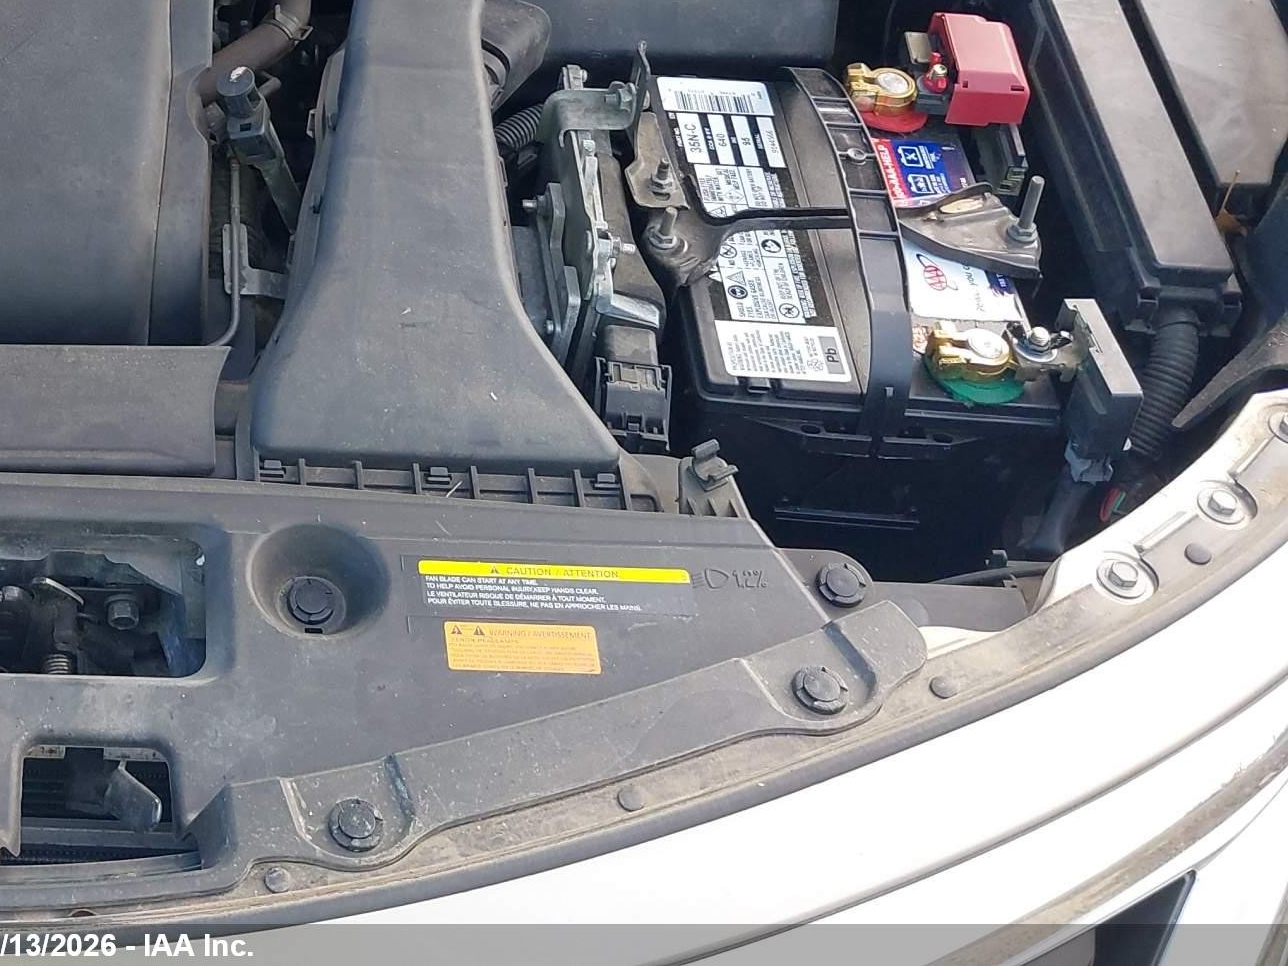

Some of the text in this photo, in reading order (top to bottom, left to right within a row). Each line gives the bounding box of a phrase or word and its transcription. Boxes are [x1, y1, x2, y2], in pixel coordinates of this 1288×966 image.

[684, 124, 702, 153] 35N-C
[824, 347, 839, 362] Pb
[506, 567, 551, 576] CAUTION
[564, 569, 618, 578] ATTENTION
